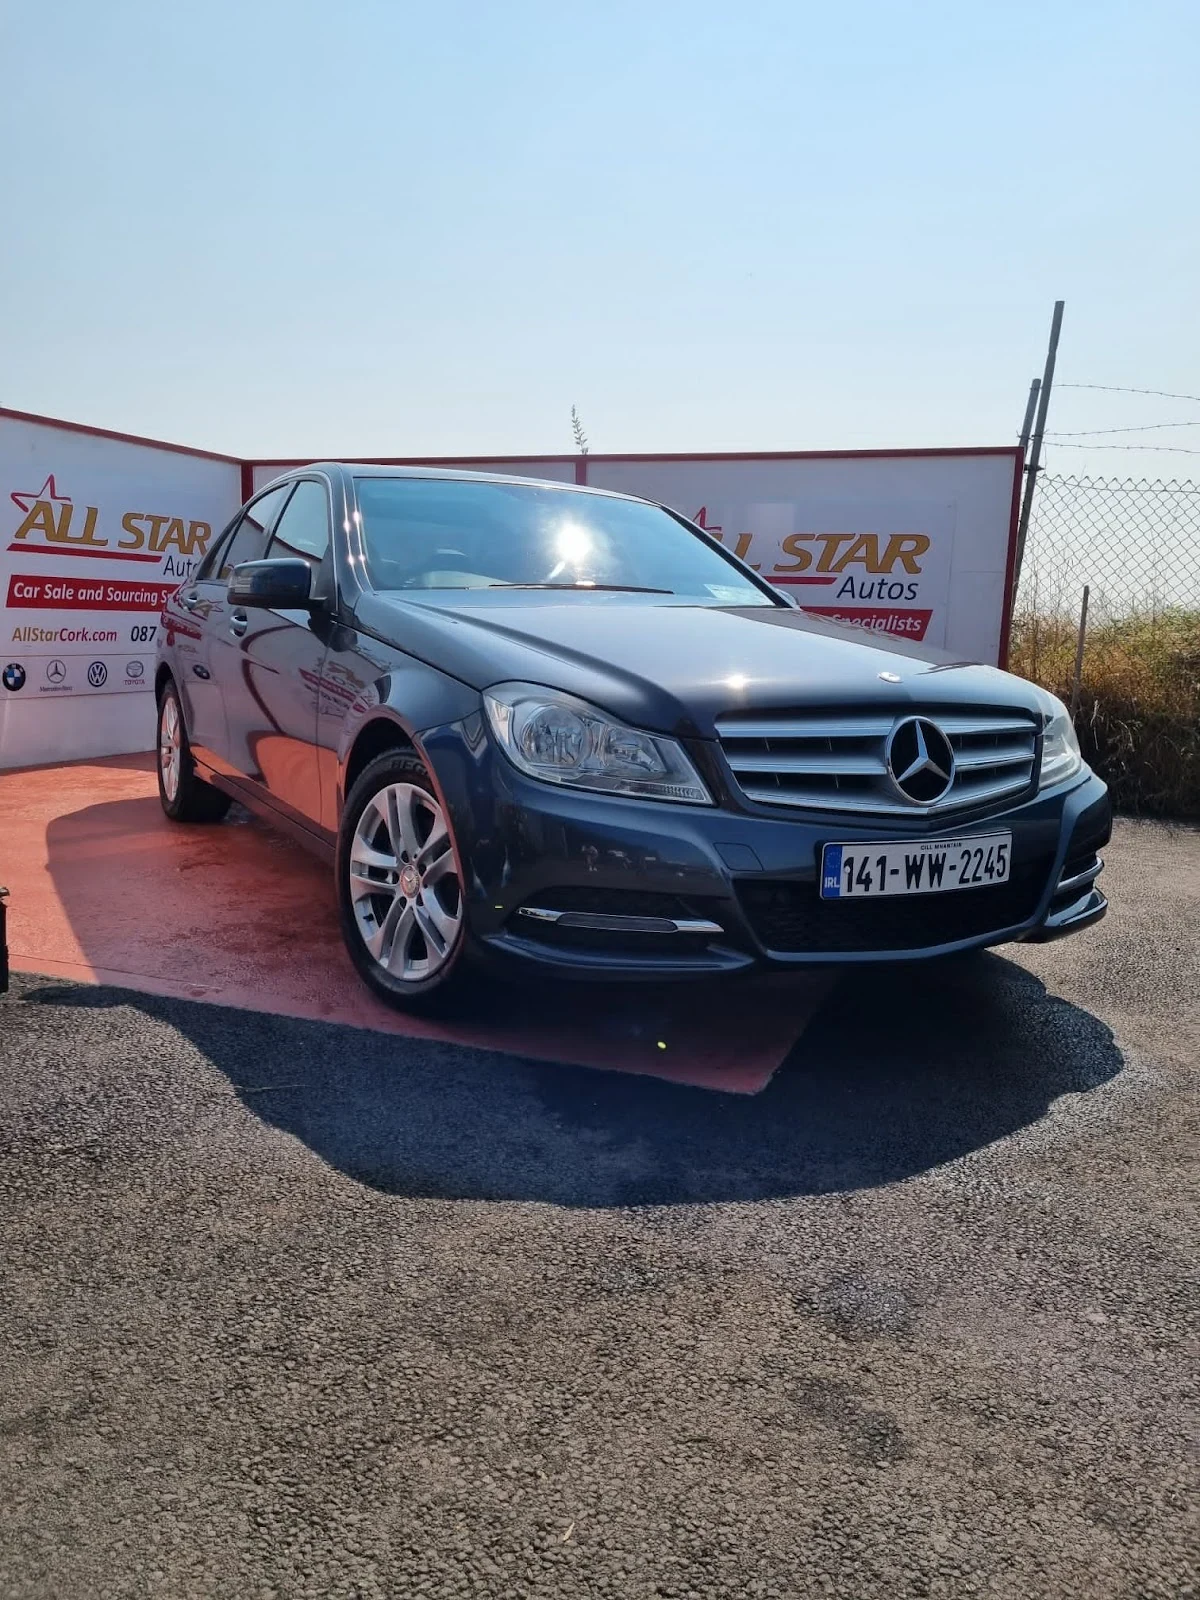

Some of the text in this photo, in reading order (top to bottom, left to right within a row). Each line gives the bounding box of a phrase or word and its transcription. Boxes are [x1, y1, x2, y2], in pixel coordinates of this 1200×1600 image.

[14, 500, 212, 556] ALL STAR
[773, 533, 930, 574] STAR
[13, 582, 40, 598] Car
[43, 584, 74, 600] Sale
[78, 587, 103, 601] and
[106, 587, 158, 606] Sourcing
[836, 576, 919, 601] Autos
[11, 627, 118, 642] AllStarCork.com
[130, 626, 157, 642] 087
[843, 844, 1008, 893] 141-WW-2245
[824, 877, 841, 889] IRL
